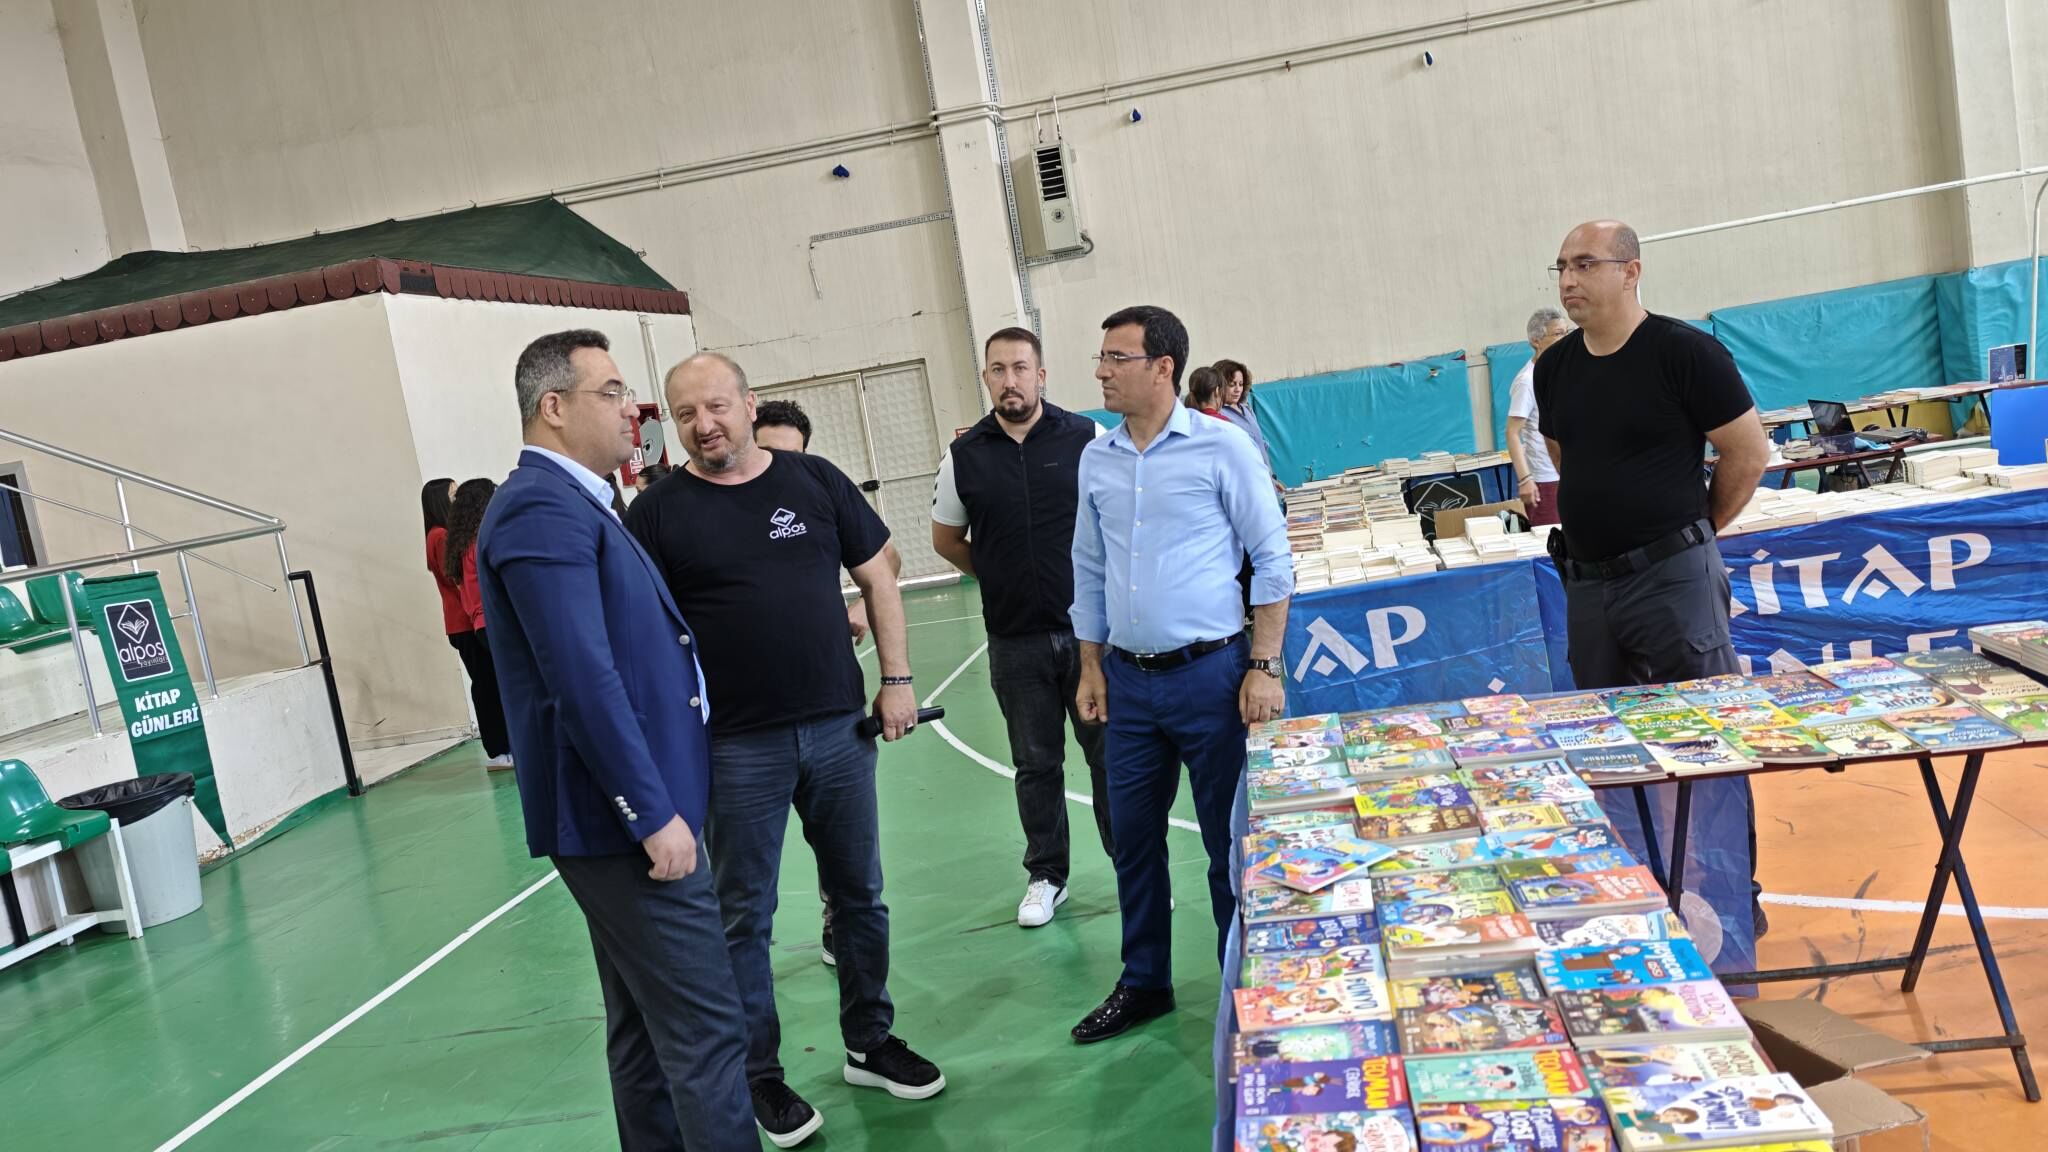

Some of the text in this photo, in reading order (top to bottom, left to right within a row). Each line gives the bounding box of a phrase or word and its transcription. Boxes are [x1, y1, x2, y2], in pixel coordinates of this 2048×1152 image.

[769, 522, 806, 540] alpos
[1723, 532, 1992, 619] İTAP
[119, 641, 165, 665] alpos
[134, 688, 181, 713] KİTAP
[130, 702, 199, 738] GÜNLERİ
